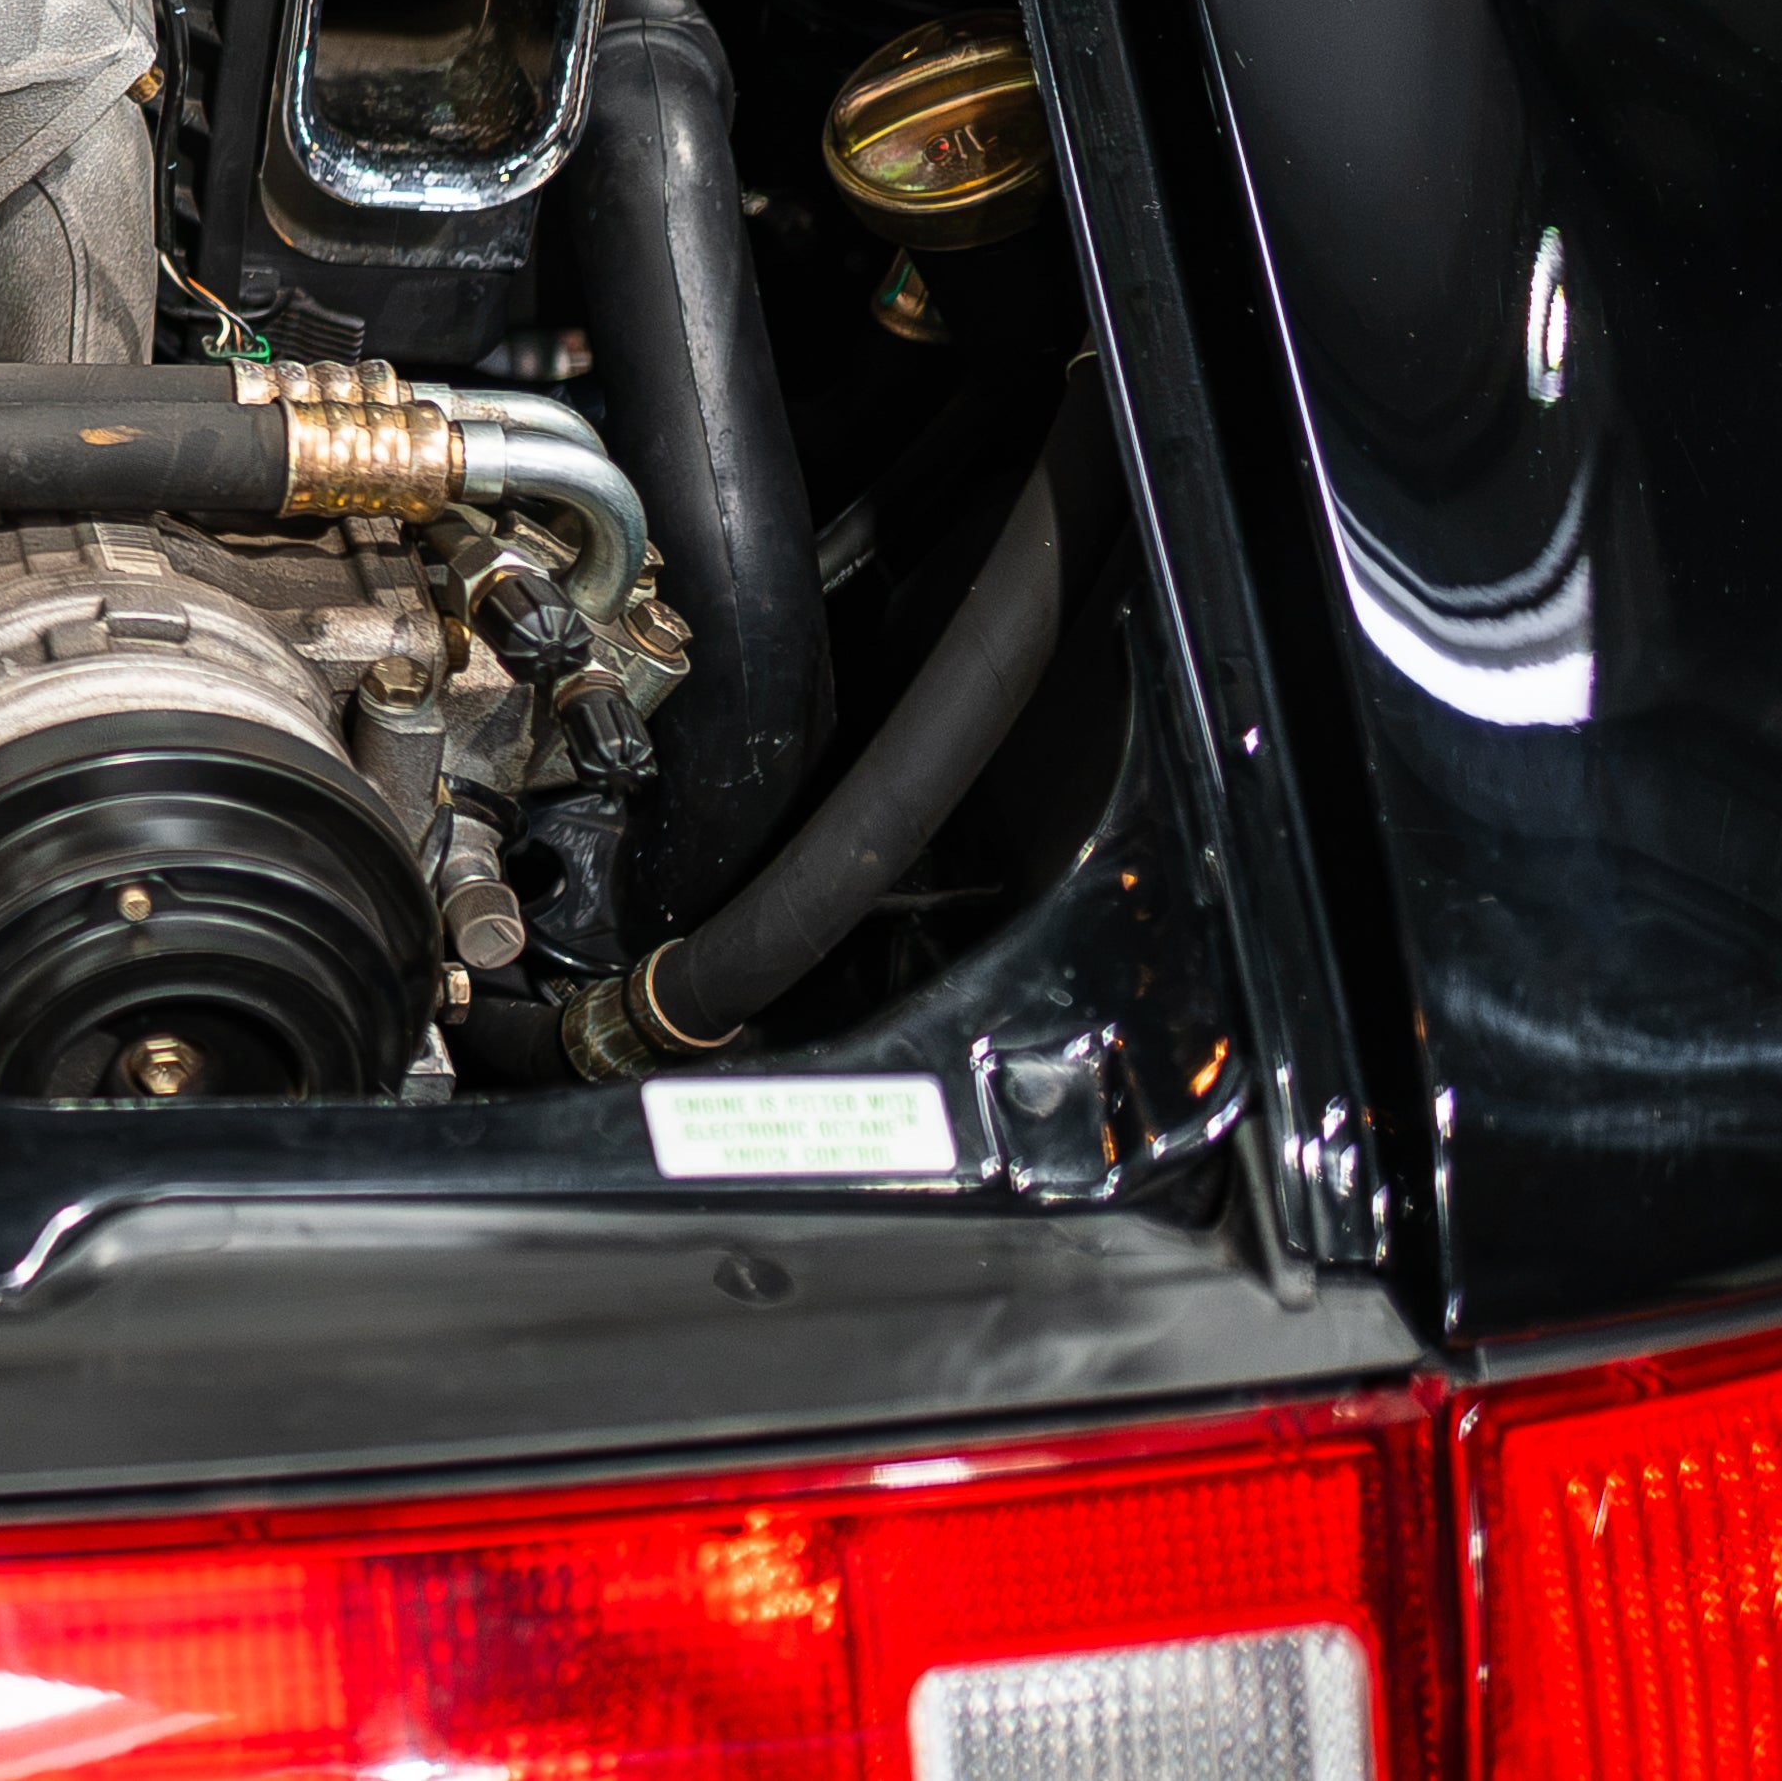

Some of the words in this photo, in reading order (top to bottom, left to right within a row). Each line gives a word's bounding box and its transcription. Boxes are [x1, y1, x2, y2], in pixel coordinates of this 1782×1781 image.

[674, 1096, 750, 1115] ENGINE
[758, 1095, 776, 1113] IS
[788, 1094, 858, 1113] FITTED
[867, 1093, 919, 1112] WITH
[683, 1119, 808, 1141] ELECTRONIC
[721, 1146, 791, 1166] KNOCK
[803, 1145, 893, 1165] CONTROL
